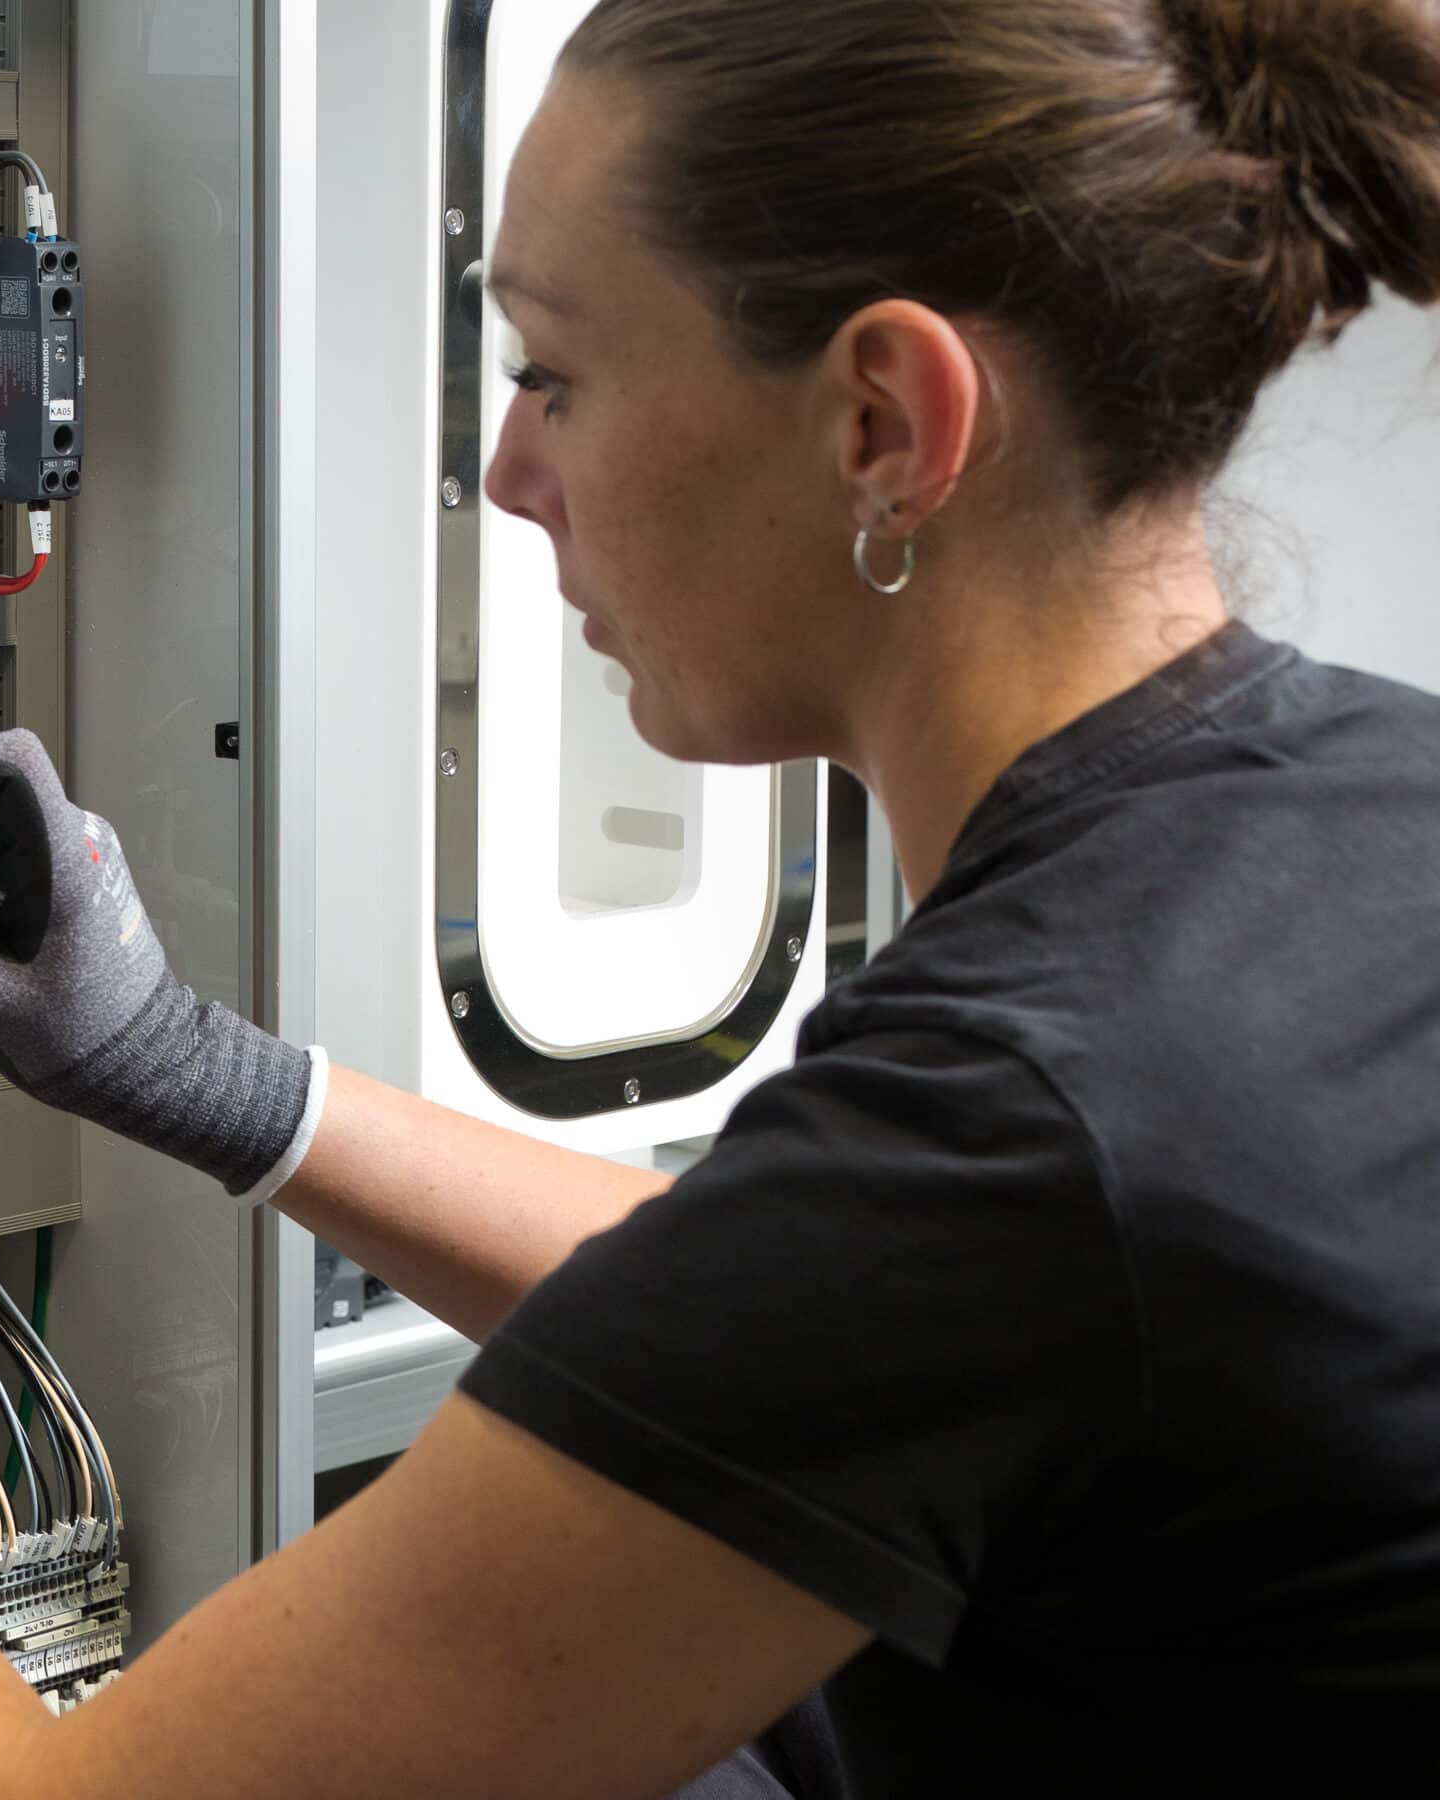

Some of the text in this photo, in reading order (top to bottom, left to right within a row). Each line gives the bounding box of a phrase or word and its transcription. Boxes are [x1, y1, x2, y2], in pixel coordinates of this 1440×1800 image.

[50, 407, 71, 416] KA05
[48, 1656, 54, 1666] 91
[56, 1654, 62, 1663] 92
[65, 1651, 71, 1660] 93
[73, 1649, 79, 1658] 94
[81, 1646, 87, 1656] 95
[98, 1641, 103, 1651] 97
